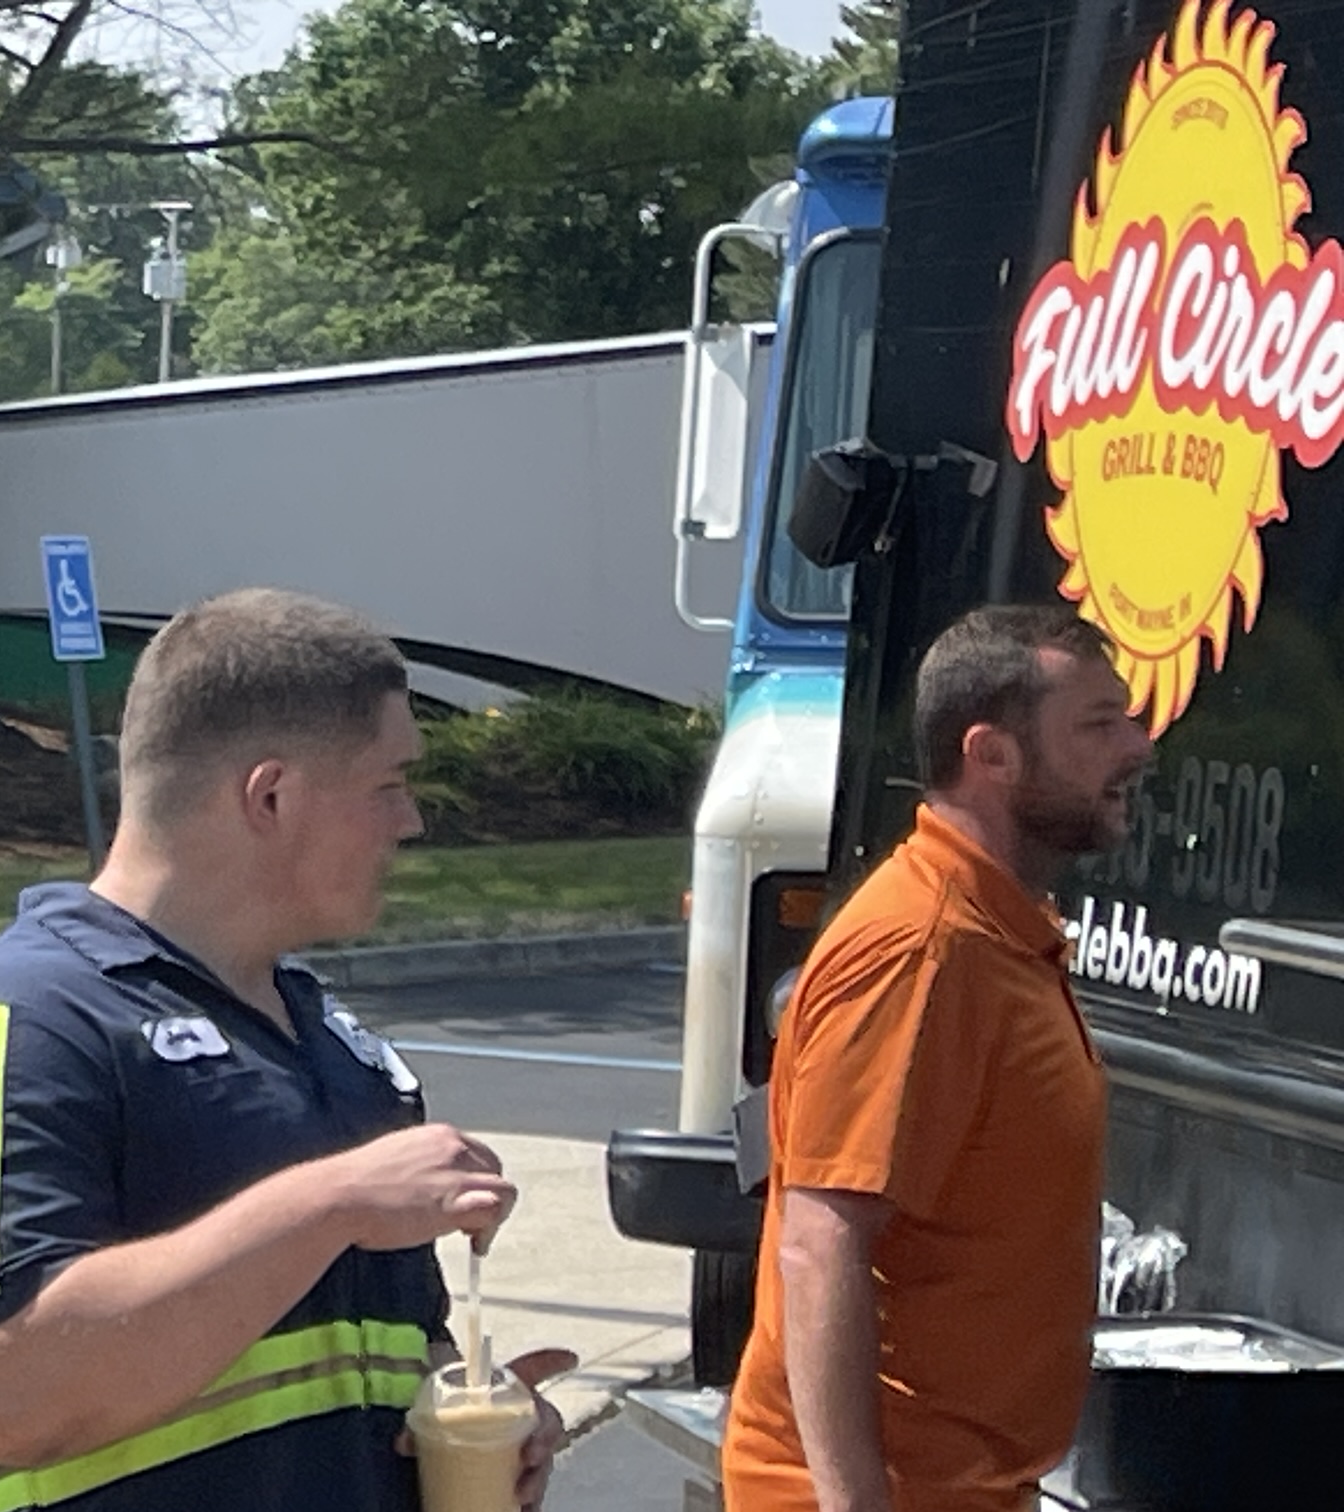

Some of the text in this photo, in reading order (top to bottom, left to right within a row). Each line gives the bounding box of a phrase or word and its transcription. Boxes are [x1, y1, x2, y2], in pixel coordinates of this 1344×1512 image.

[1015, 240, 1344, 440] Full Circle
[1102, 431, 1225, 496] GRILL & BBQ
